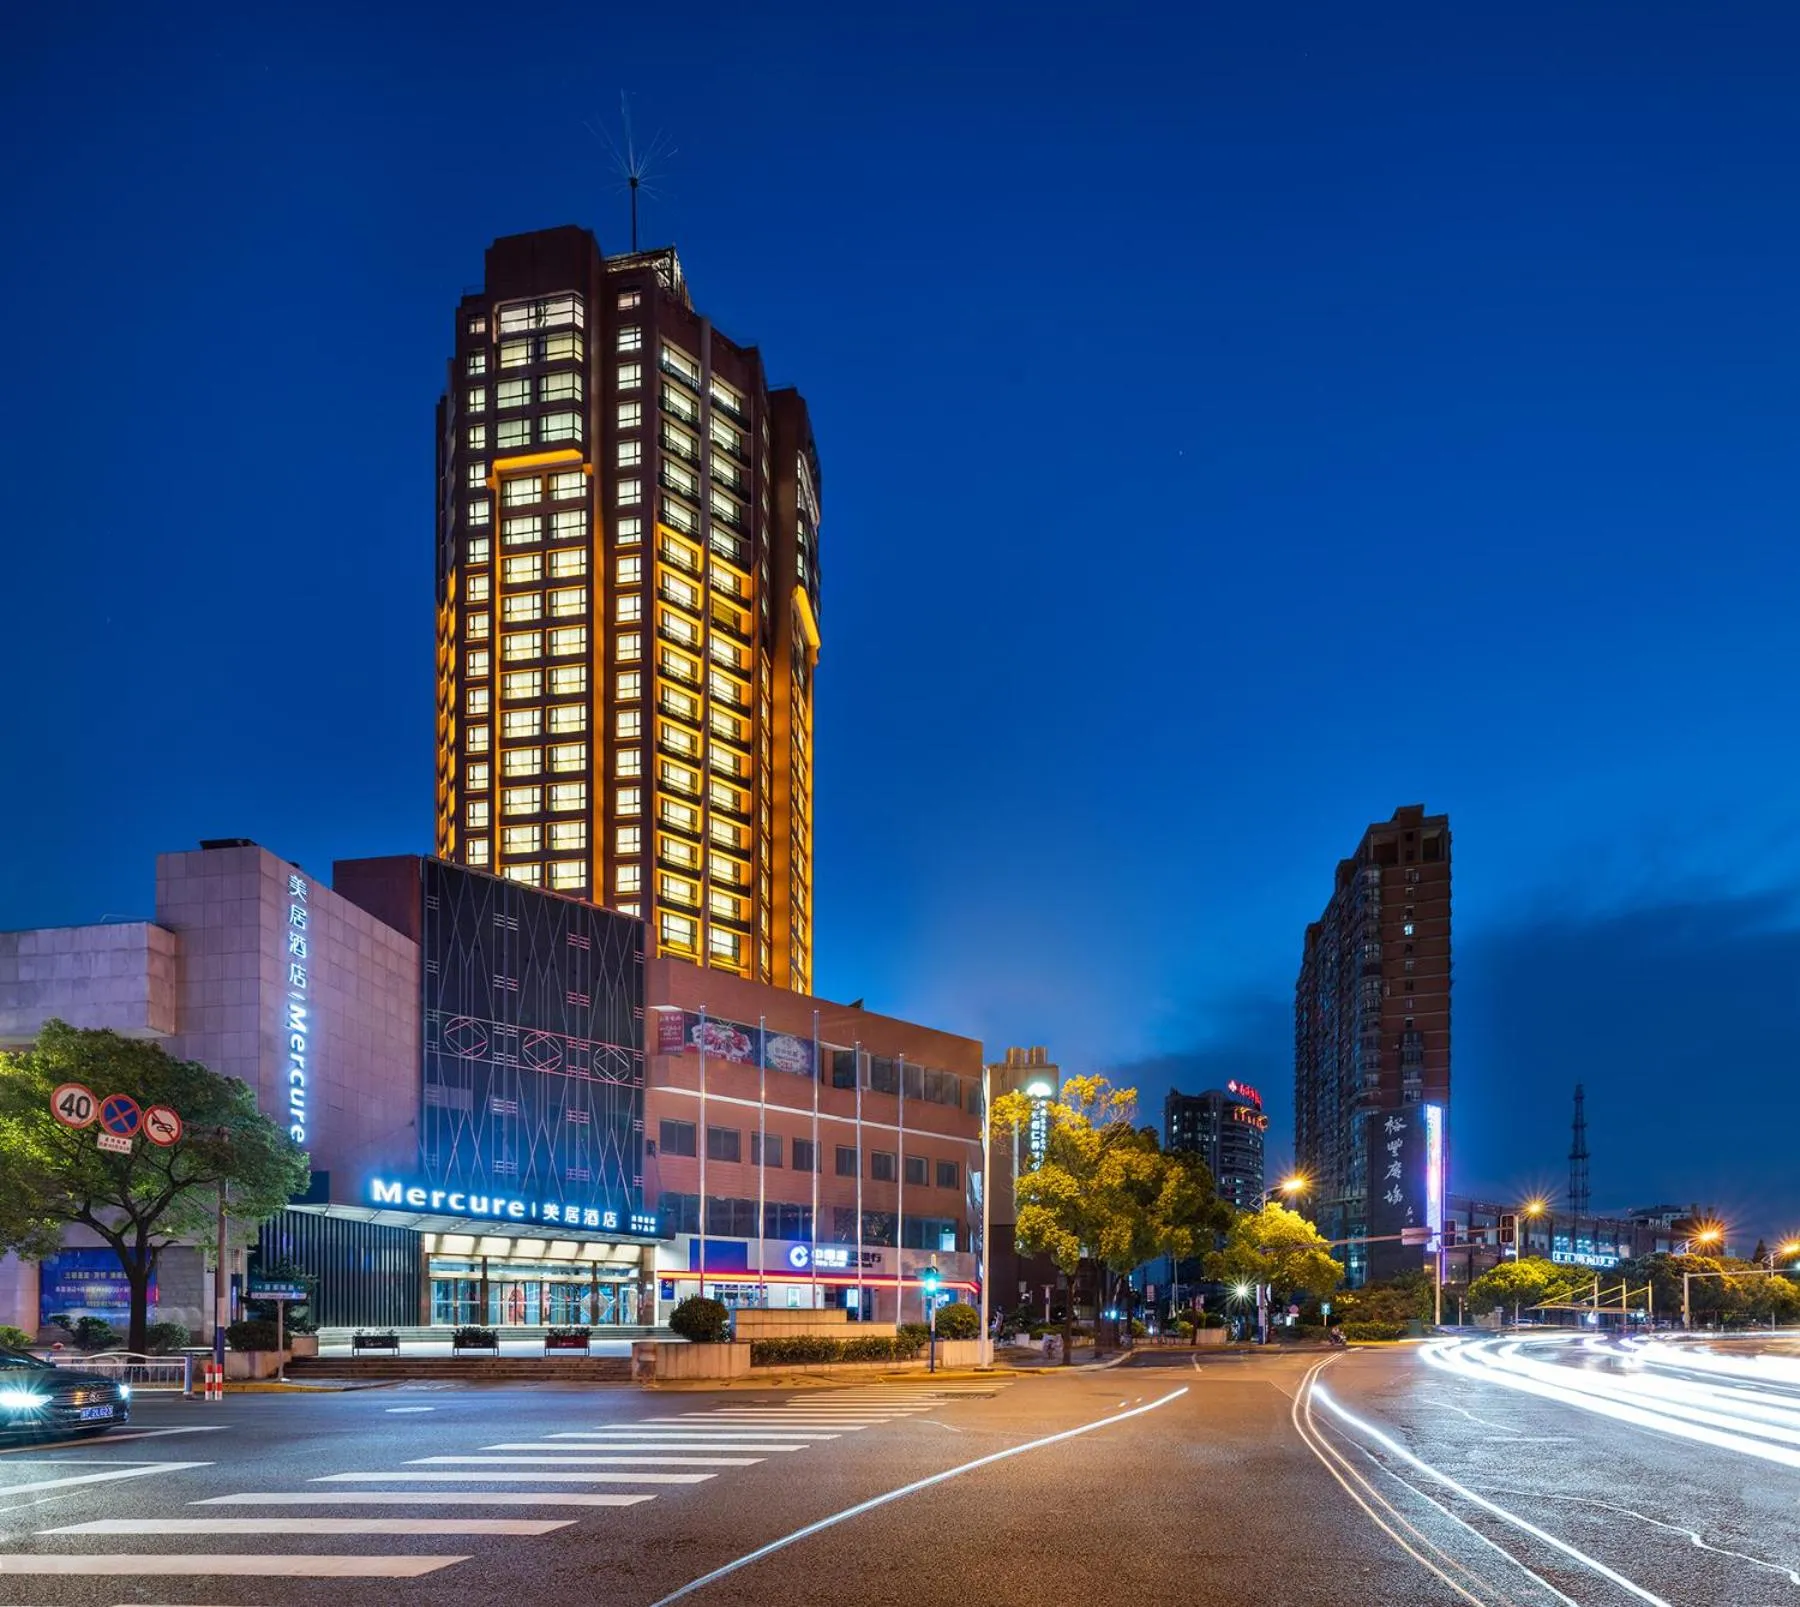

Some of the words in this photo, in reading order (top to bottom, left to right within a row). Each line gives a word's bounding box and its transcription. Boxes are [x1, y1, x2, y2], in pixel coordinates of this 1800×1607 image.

[286, 874, 307, 989] 美居酒店
[287, 1003, 307, 1143] Mercure
[59, 1093, 91, 1119] 40
[371, 1179, 526, 1218] Mercure
[543, 1202, 618, 1229] 美居酒店
